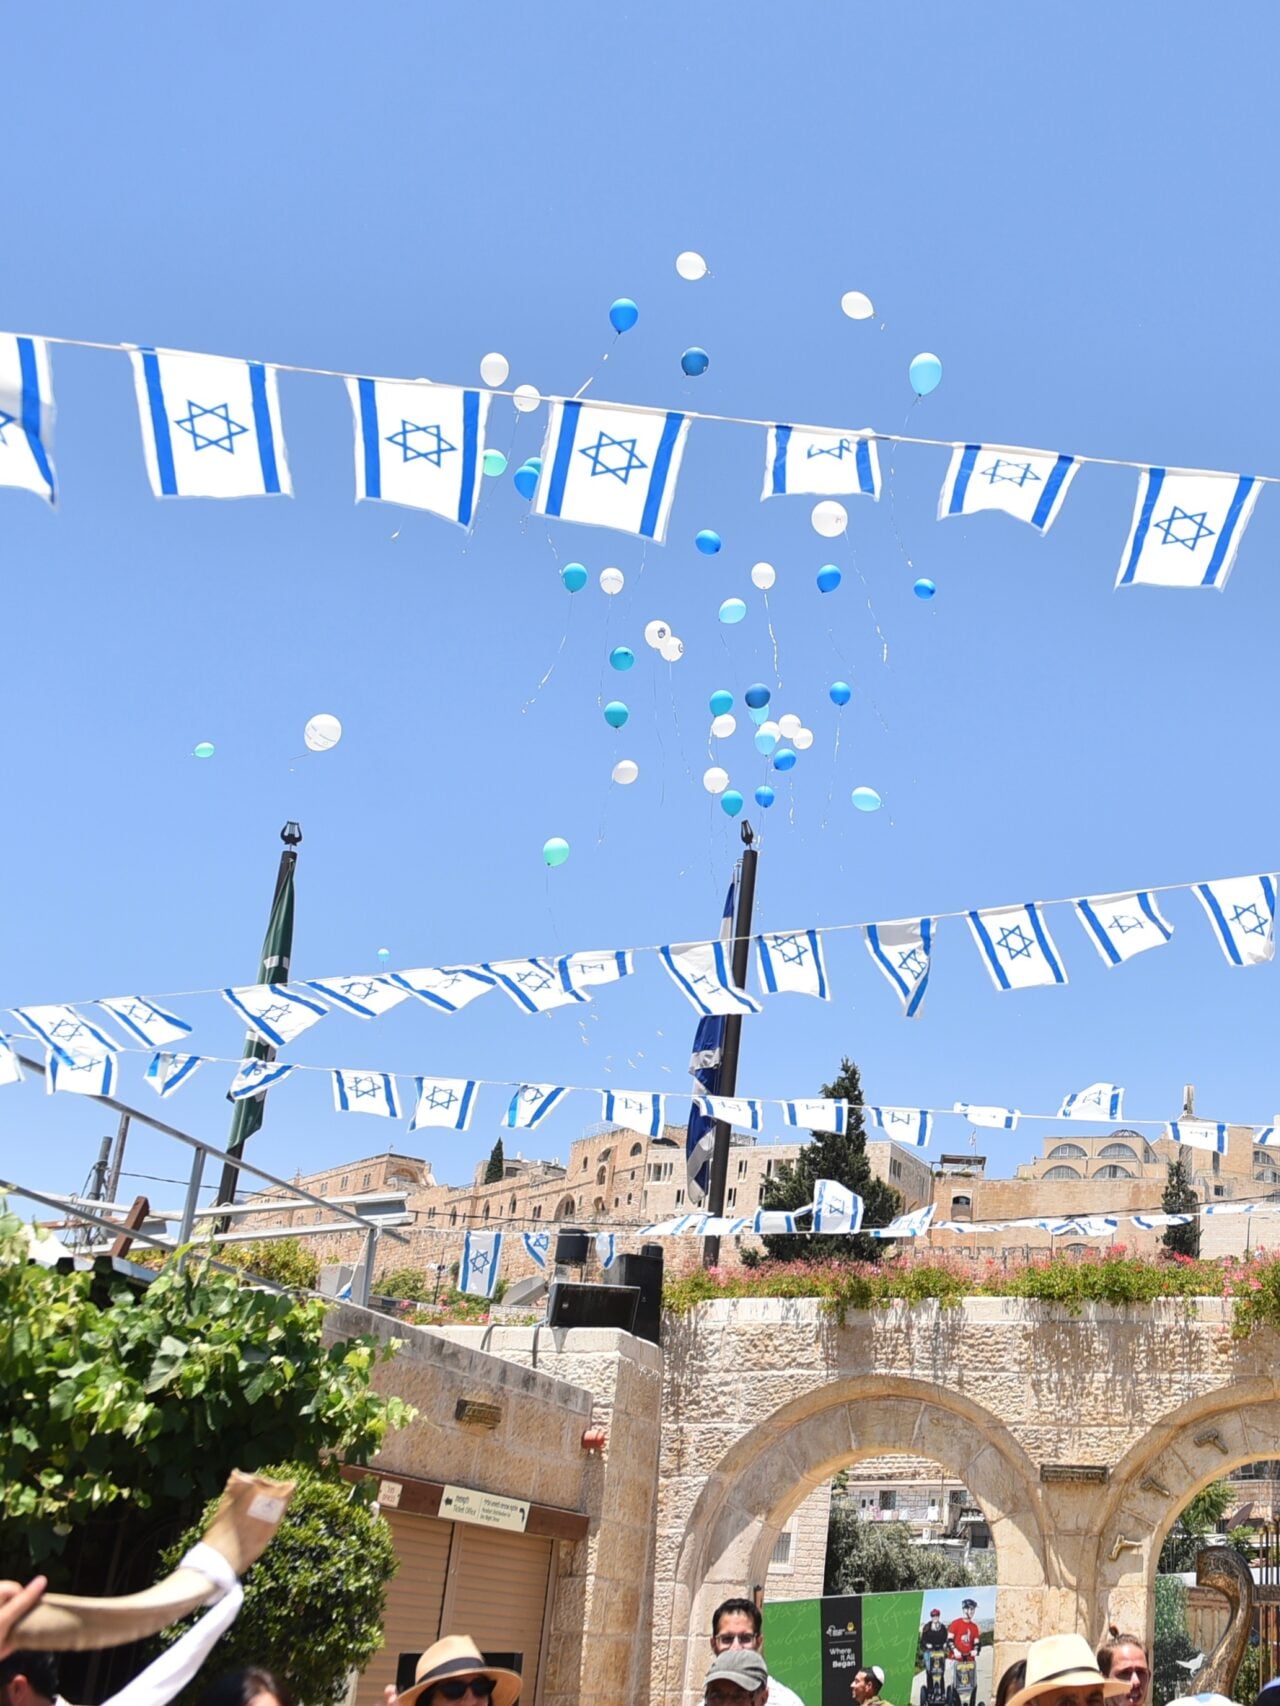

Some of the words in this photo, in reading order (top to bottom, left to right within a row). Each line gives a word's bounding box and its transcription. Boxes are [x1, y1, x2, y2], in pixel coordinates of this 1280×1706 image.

[829, 1647, 852, 1655] Where
[846, 1653, 855, 1661] All
[832, 1660, 856, 1669] Began
